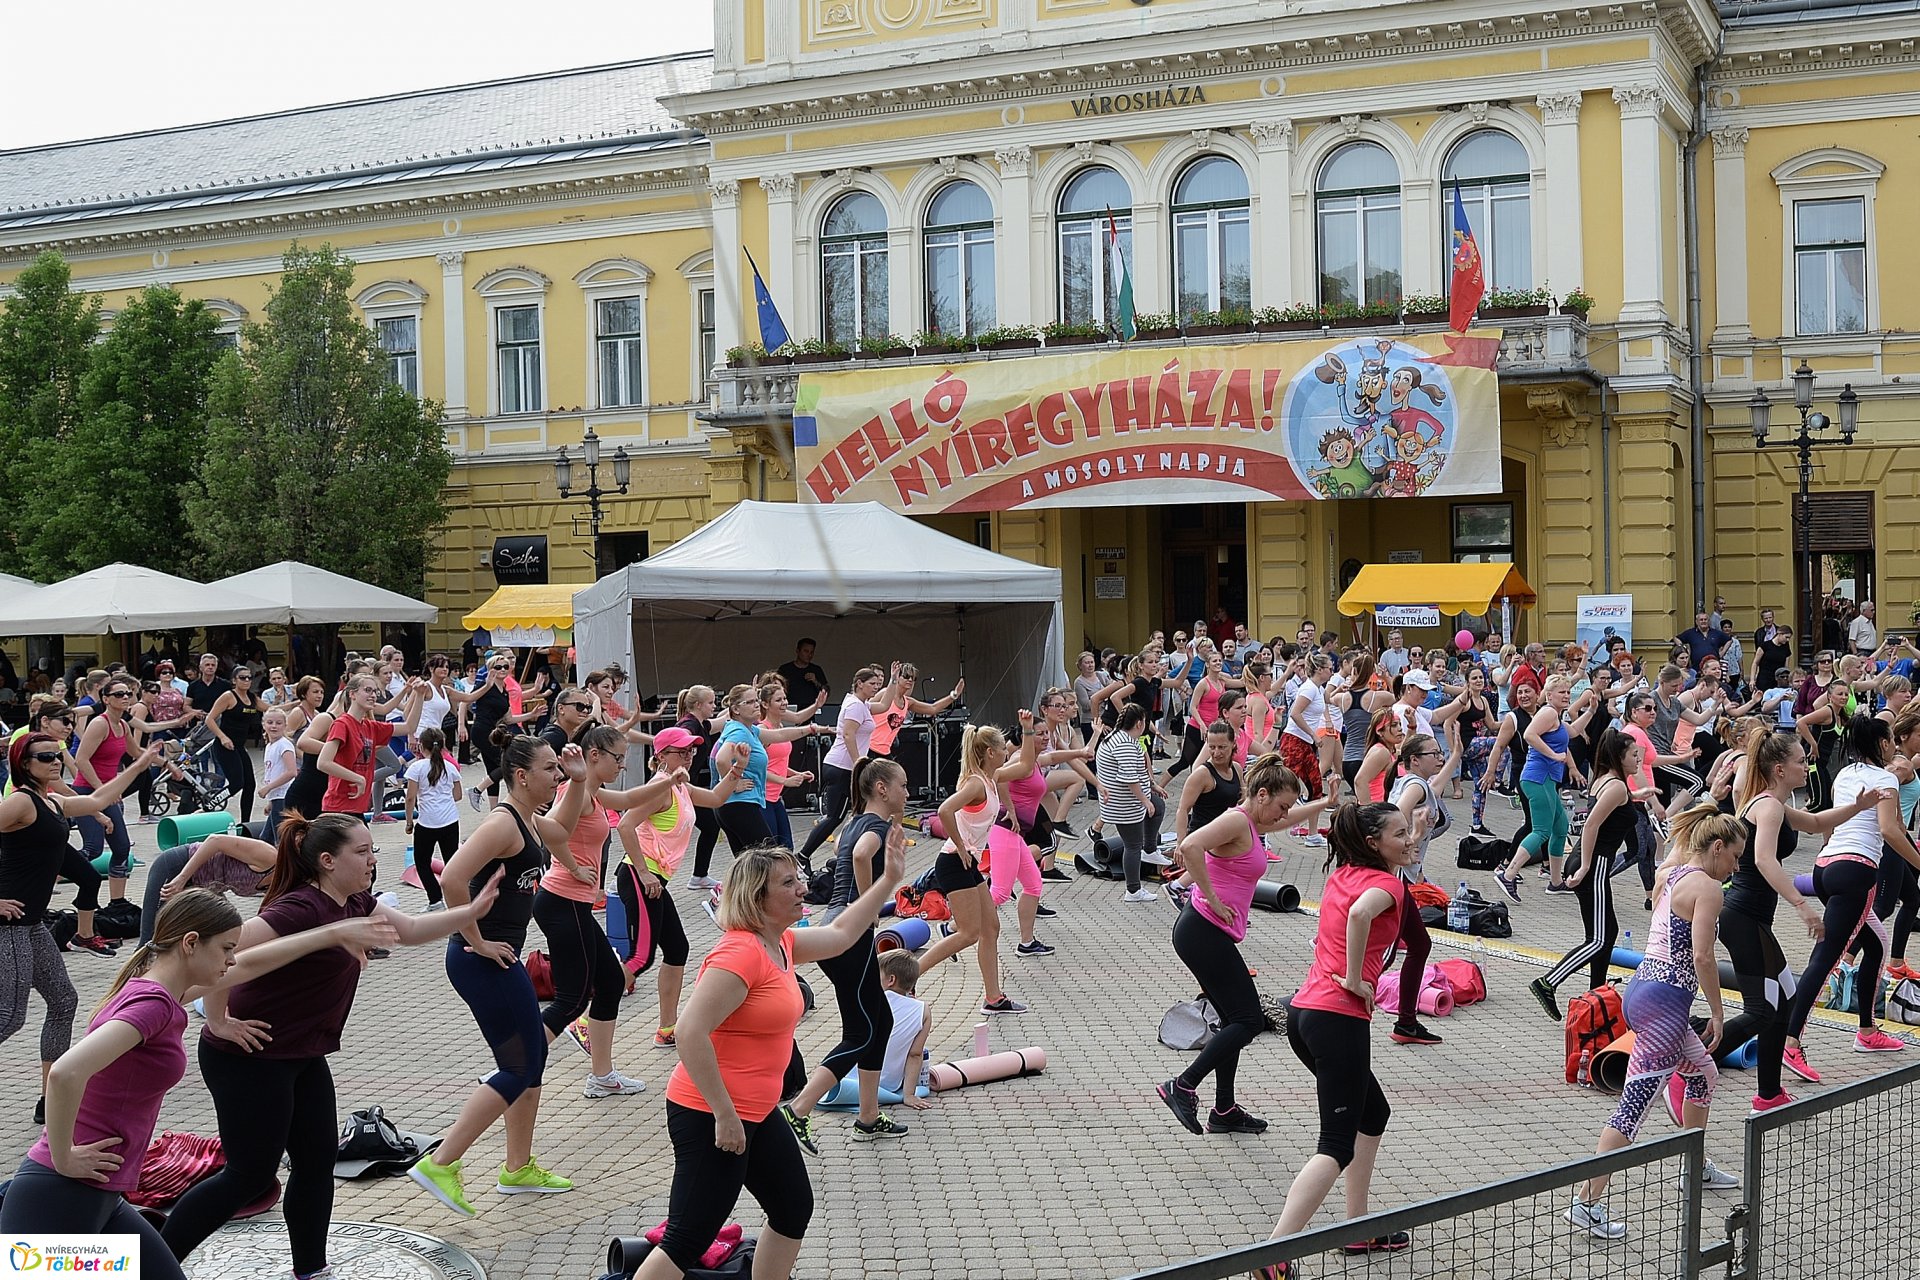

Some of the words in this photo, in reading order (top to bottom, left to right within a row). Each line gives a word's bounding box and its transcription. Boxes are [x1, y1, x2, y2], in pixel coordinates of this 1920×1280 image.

[1071, 84, 1206, 117] VÁROSHÁZA
[805, 370, 967, 504] HELLÓ
[889, 357, 1282, 509] NYÍREGYHÁZA!
[1022, 479, 1035, 498] A
[1044, 454, 1146, 490] MOSOLY
[1159, 452, 1246, 477] NAPJA
[1377, 614, 1437, 625] REGISZTRÁCIÓ
[385, 796, 406, 808] FILA
